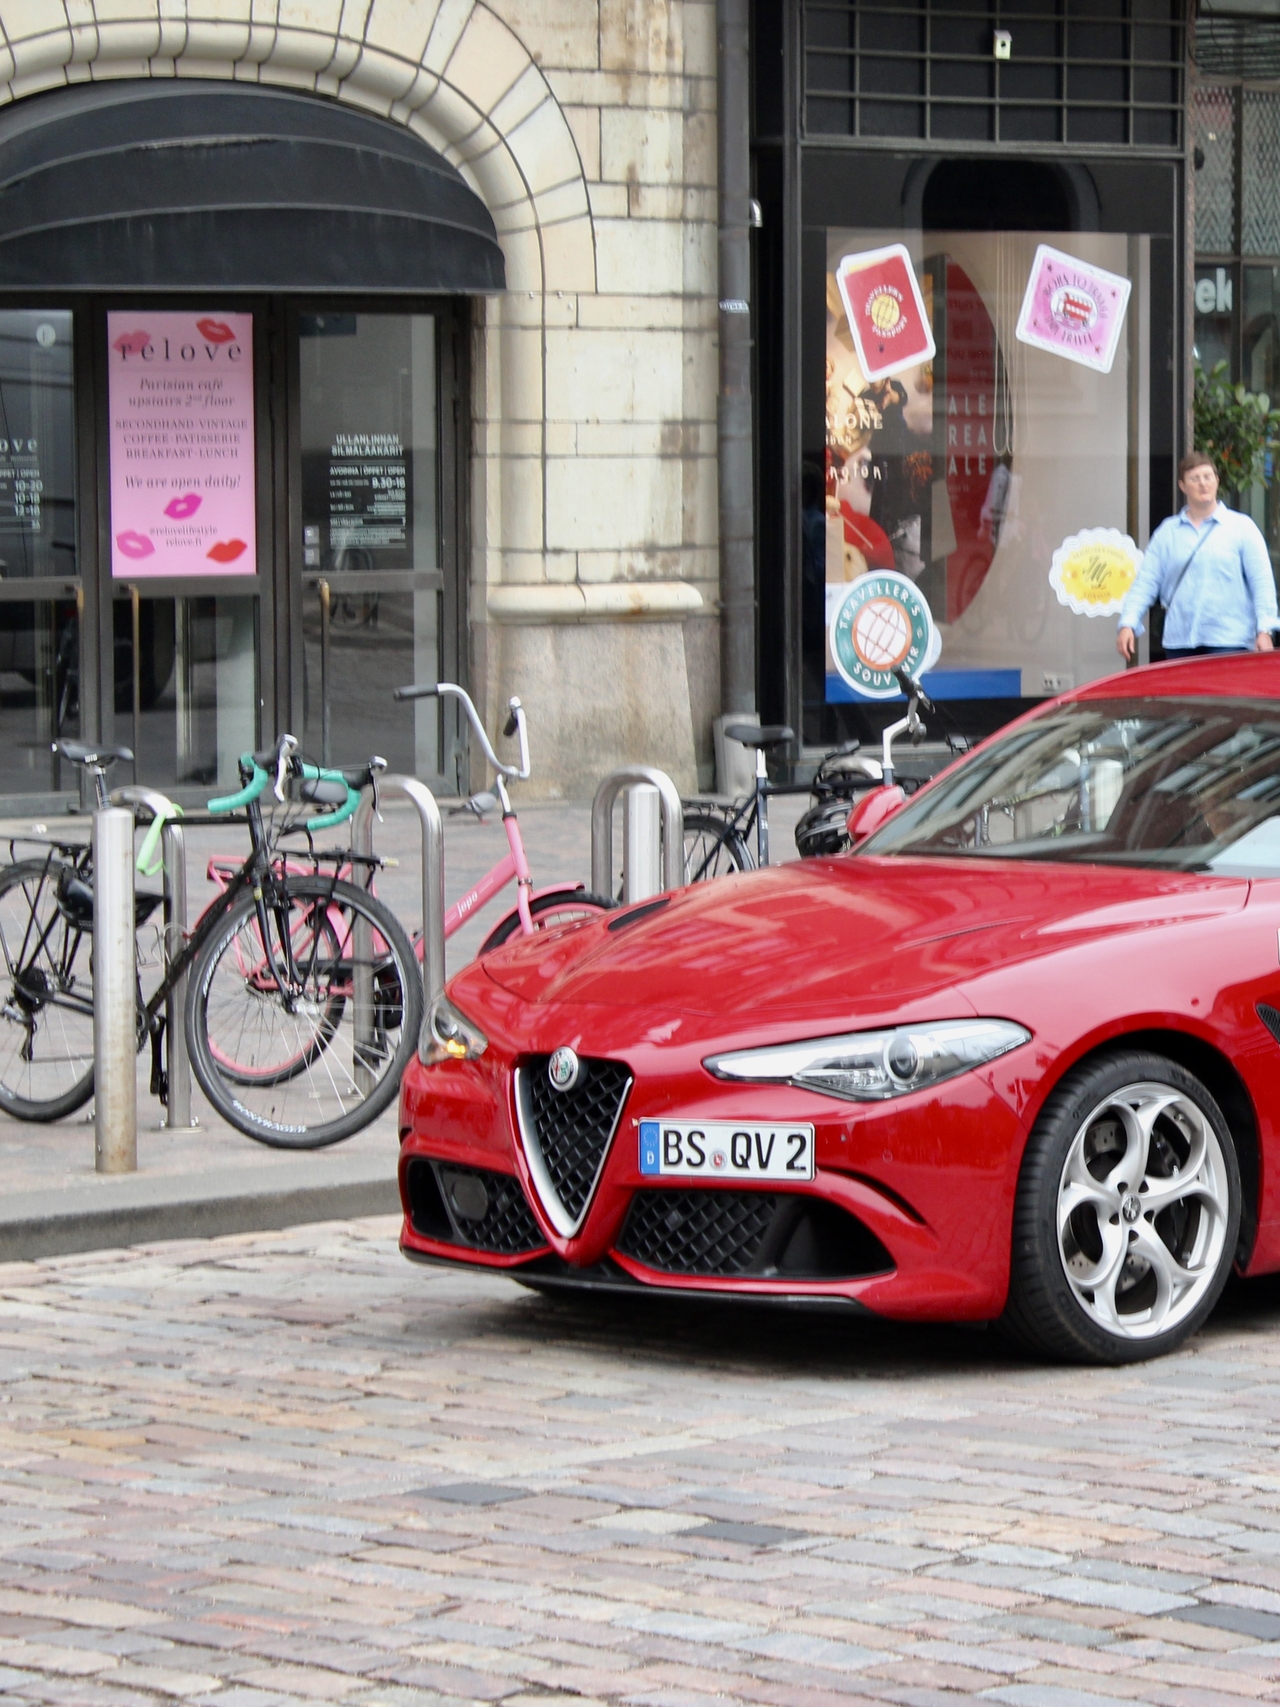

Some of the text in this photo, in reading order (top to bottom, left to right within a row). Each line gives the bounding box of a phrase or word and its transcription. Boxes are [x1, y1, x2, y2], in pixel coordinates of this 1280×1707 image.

[121, 337, 242, 363] relove
[140, 378, 194, 391] Parisian
[128, 394, 182, 409] upstairs
[202, 393, 236, 410] floor
[125, 474, 241, 491] We are open daily!
[839, 581, 920, 630] TRAVELLER'S
[853, 645, 919, 686] SOUVNIR
[646, 1151, 655, 1165] D
[663, 1129, 807, 1171] BS QV 2
